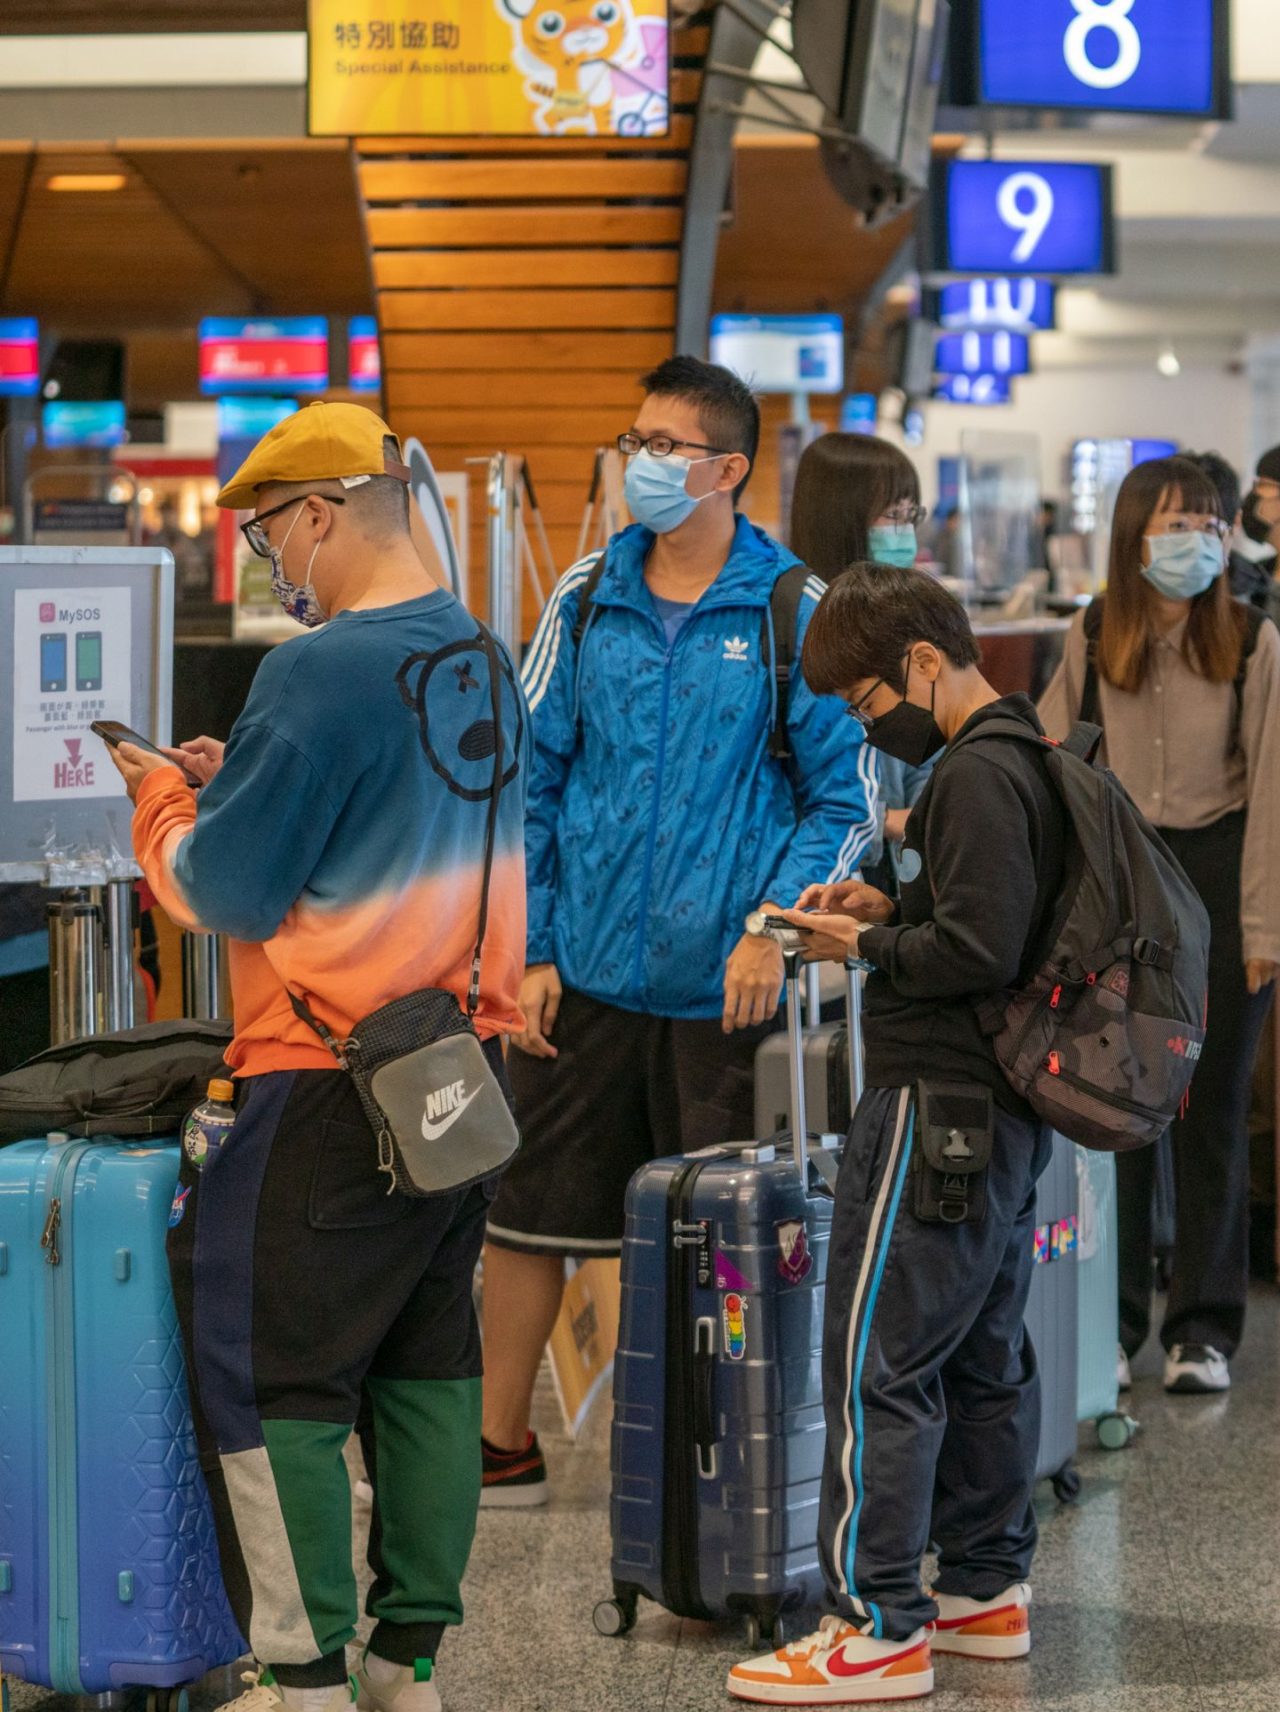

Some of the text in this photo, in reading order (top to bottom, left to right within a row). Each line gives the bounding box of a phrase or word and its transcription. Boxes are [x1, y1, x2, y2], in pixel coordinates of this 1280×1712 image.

[335, 20, 460, 49] 特別協助
[1063, 0, 1141, 89] 8
[336, 60, 510, 75] Special Assistance
[997, 171, 1054, 264] 9
[963, 331, 1011, 373] 11
[59, 608, 101, 624] MySOS
[54, 761, 95, 789] HERE
[426, 1079, 466, 1120] NIKE
